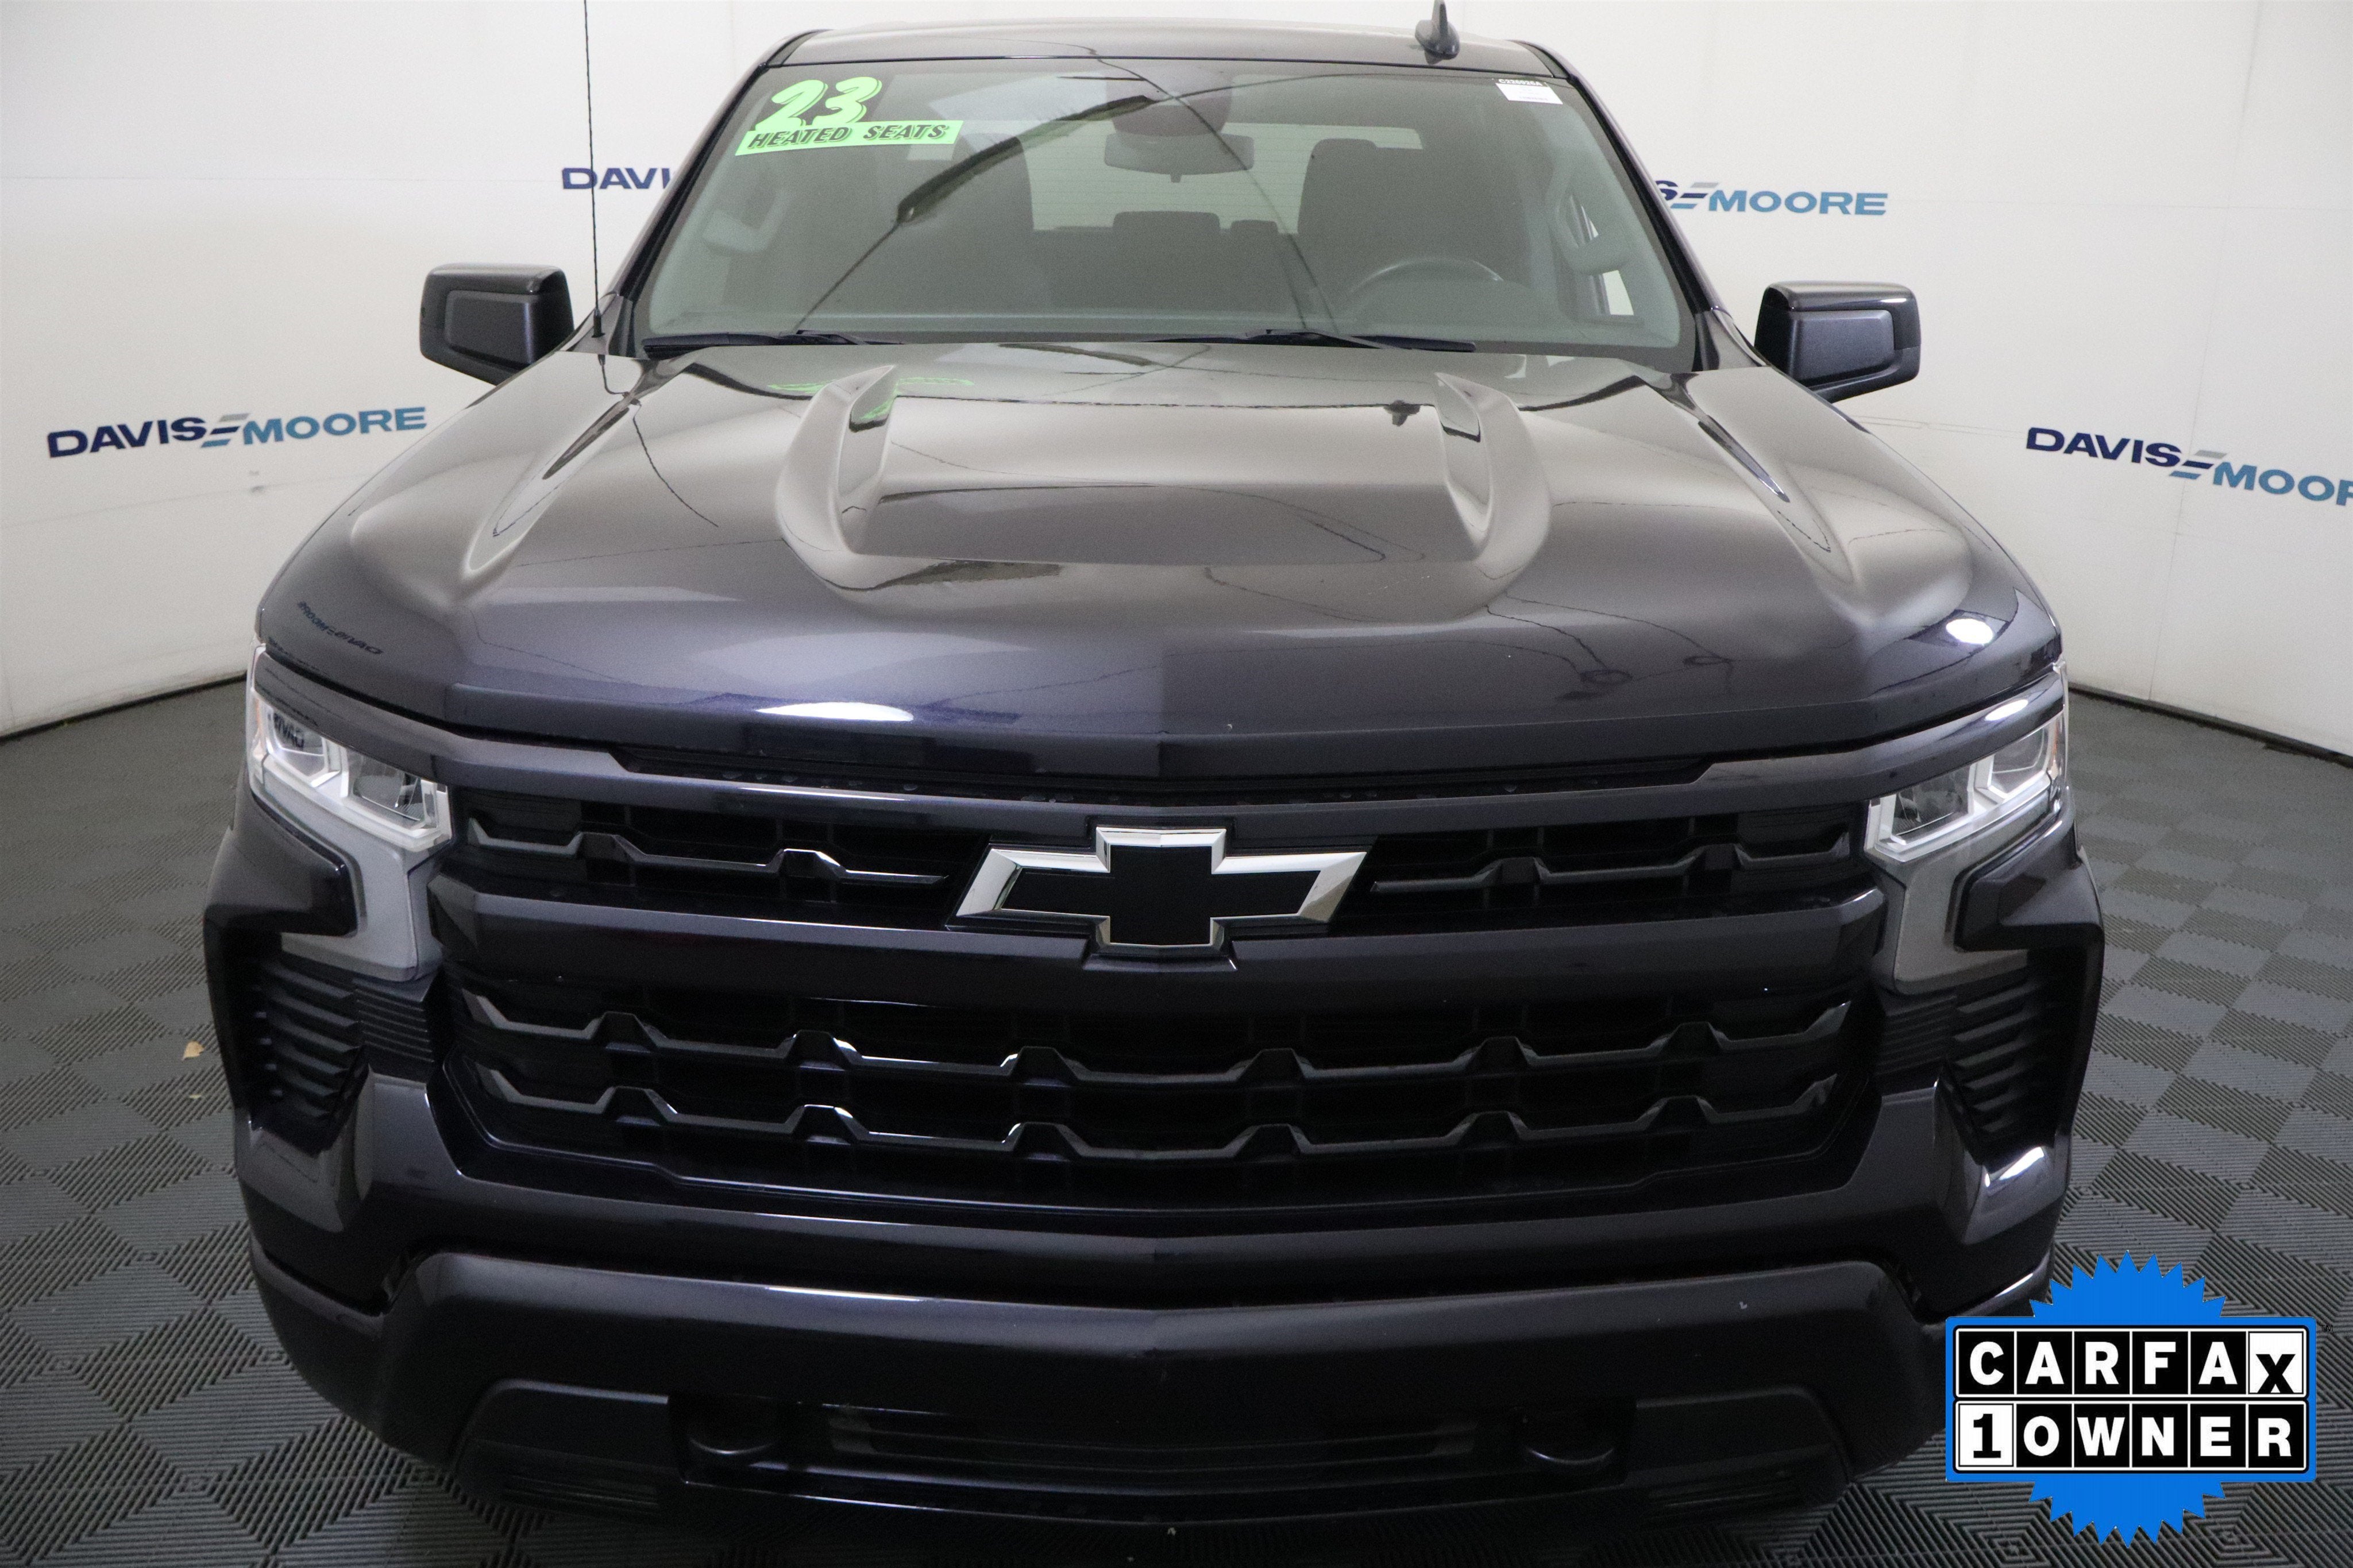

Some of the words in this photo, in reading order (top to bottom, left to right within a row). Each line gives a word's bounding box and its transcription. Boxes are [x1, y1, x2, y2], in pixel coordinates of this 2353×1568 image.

[755, 76, 882, 129] 23
[748, 126, 852, 149] HEATED
[863, 124, 948, 140] SEATS
[562, 168, 670, 189] DAVI
[1708, 190, 1888, 215] MOORE
[47, 417, 207, 458] DAVIS
[244, 407, 427, 445] MOORE
[2026, 427, 2182, 467] DAVIS
[2213, 462, 2353, 506] MOO
